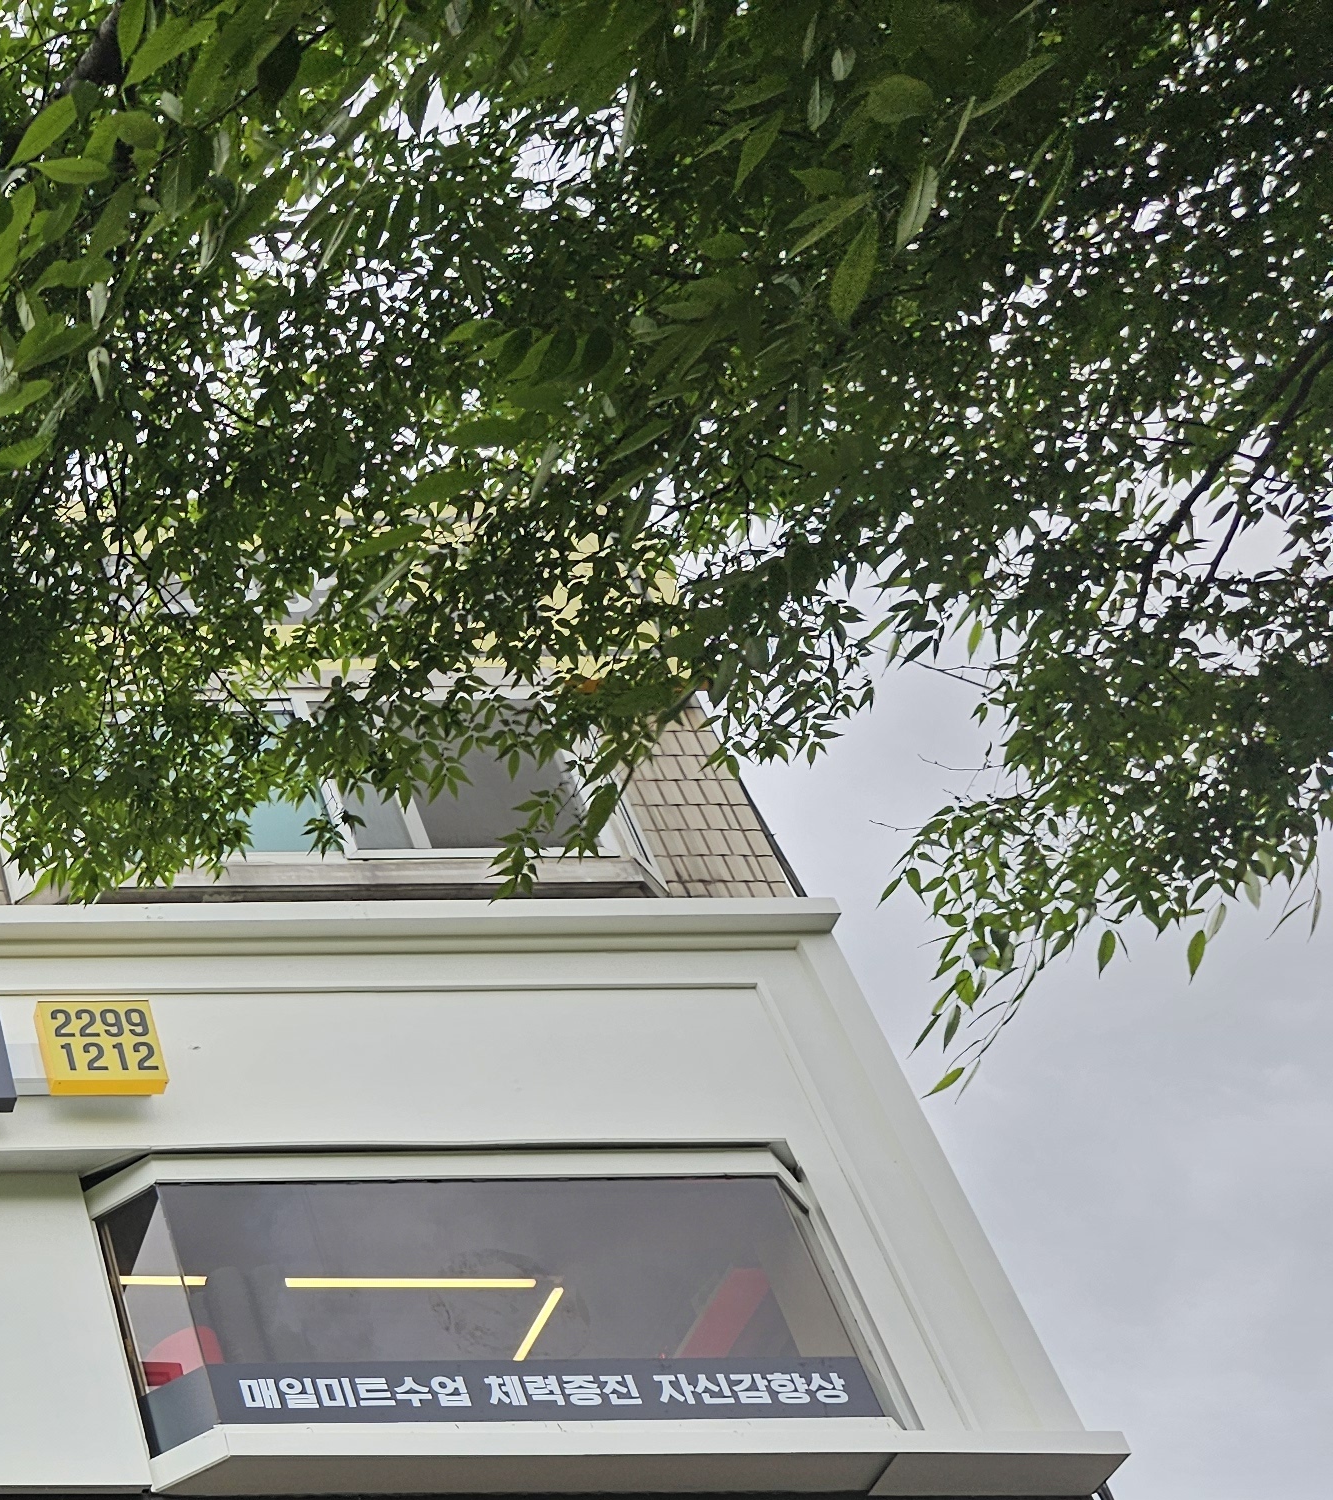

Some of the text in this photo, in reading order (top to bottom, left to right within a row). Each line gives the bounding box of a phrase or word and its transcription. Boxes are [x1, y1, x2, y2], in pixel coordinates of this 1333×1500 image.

[50, 1007, 150, 1038] 2299
[60, 1042, 160, 1071] 1212
[238, 1372, 848, 1409] 매일미트수업 체력증진 자신감향상
